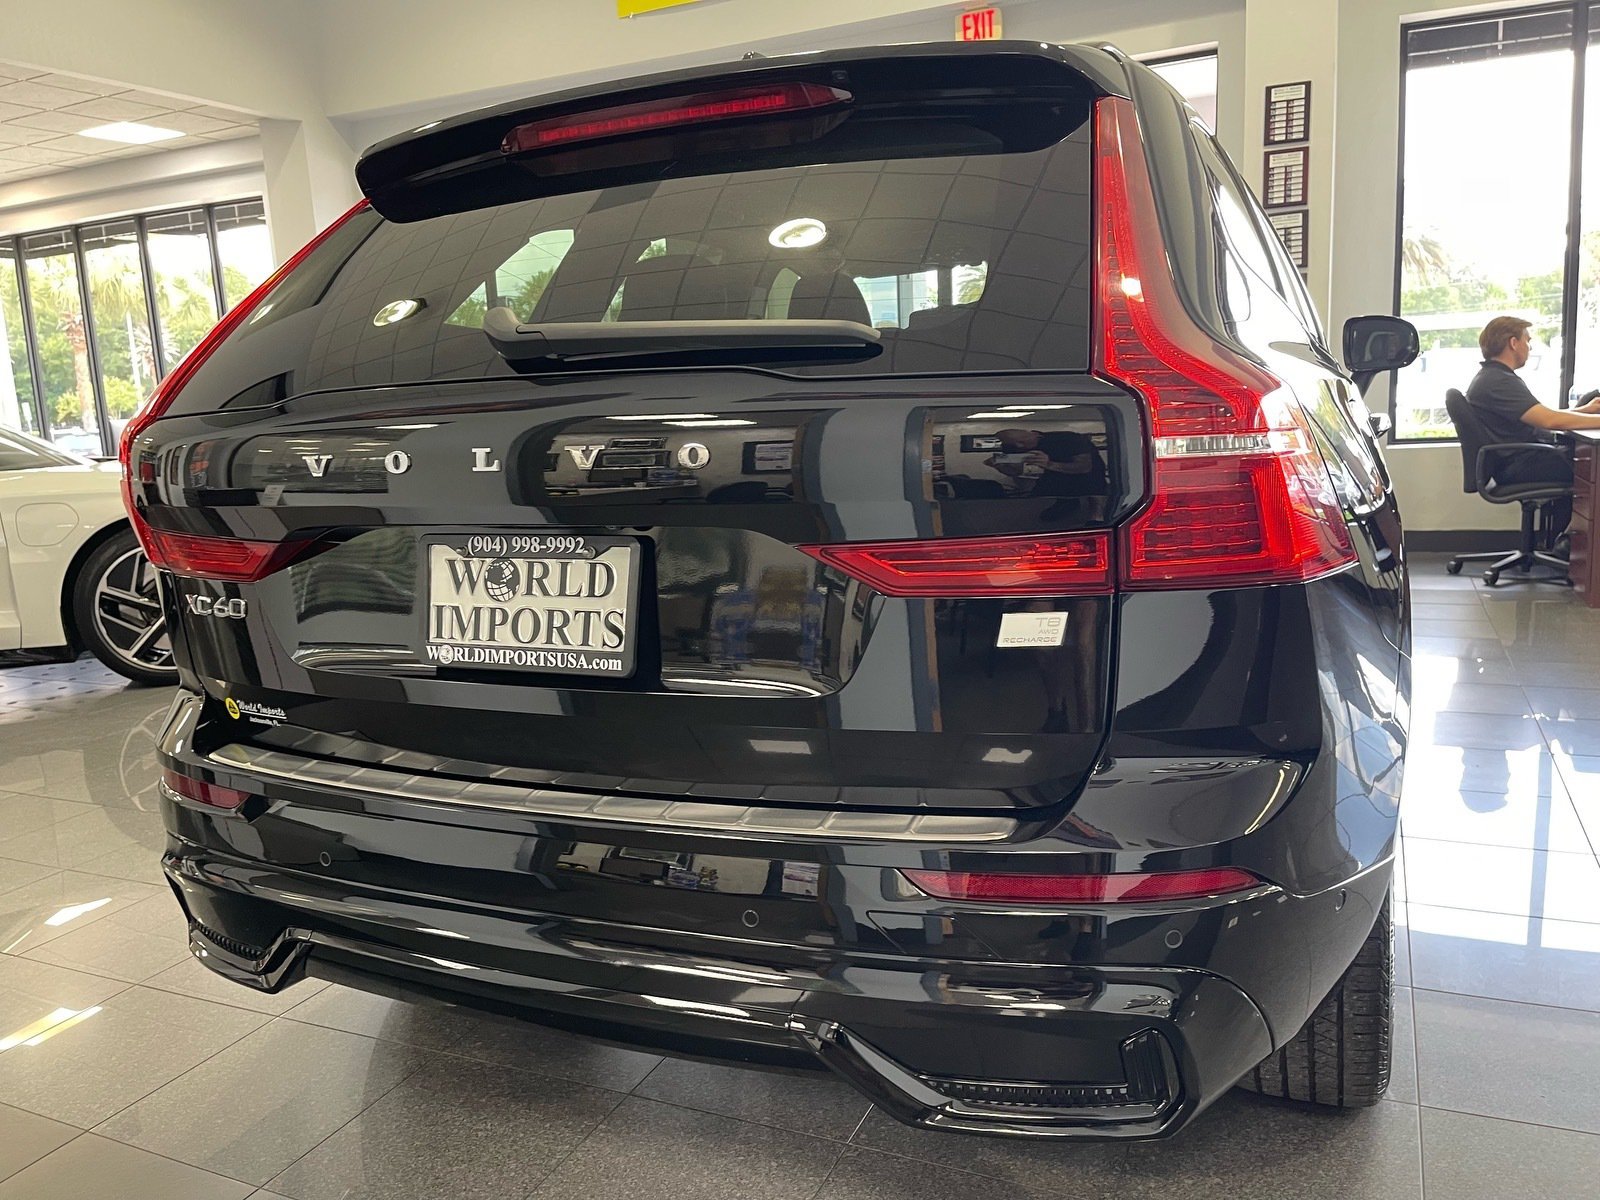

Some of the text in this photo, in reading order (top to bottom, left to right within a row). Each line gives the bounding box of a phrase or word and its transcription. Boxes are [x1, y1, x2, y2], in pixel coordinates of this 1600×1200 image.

[962, 9, 994, 41] EXIT
[301, 442, 711, 479] VOLVO
[467, 536, 585, 556] (904) 998-9992
[446, 557, 616, 602] WORLD
[185, 594, 247, 619] XC60
[432, 604, 624, 648] IMPORTS
[1035, 617, 1061, 627] T8
[426, 644, 622, 671] WORLDIMPORTSUSA.com
[237, 700, 286, 716] World Imports
